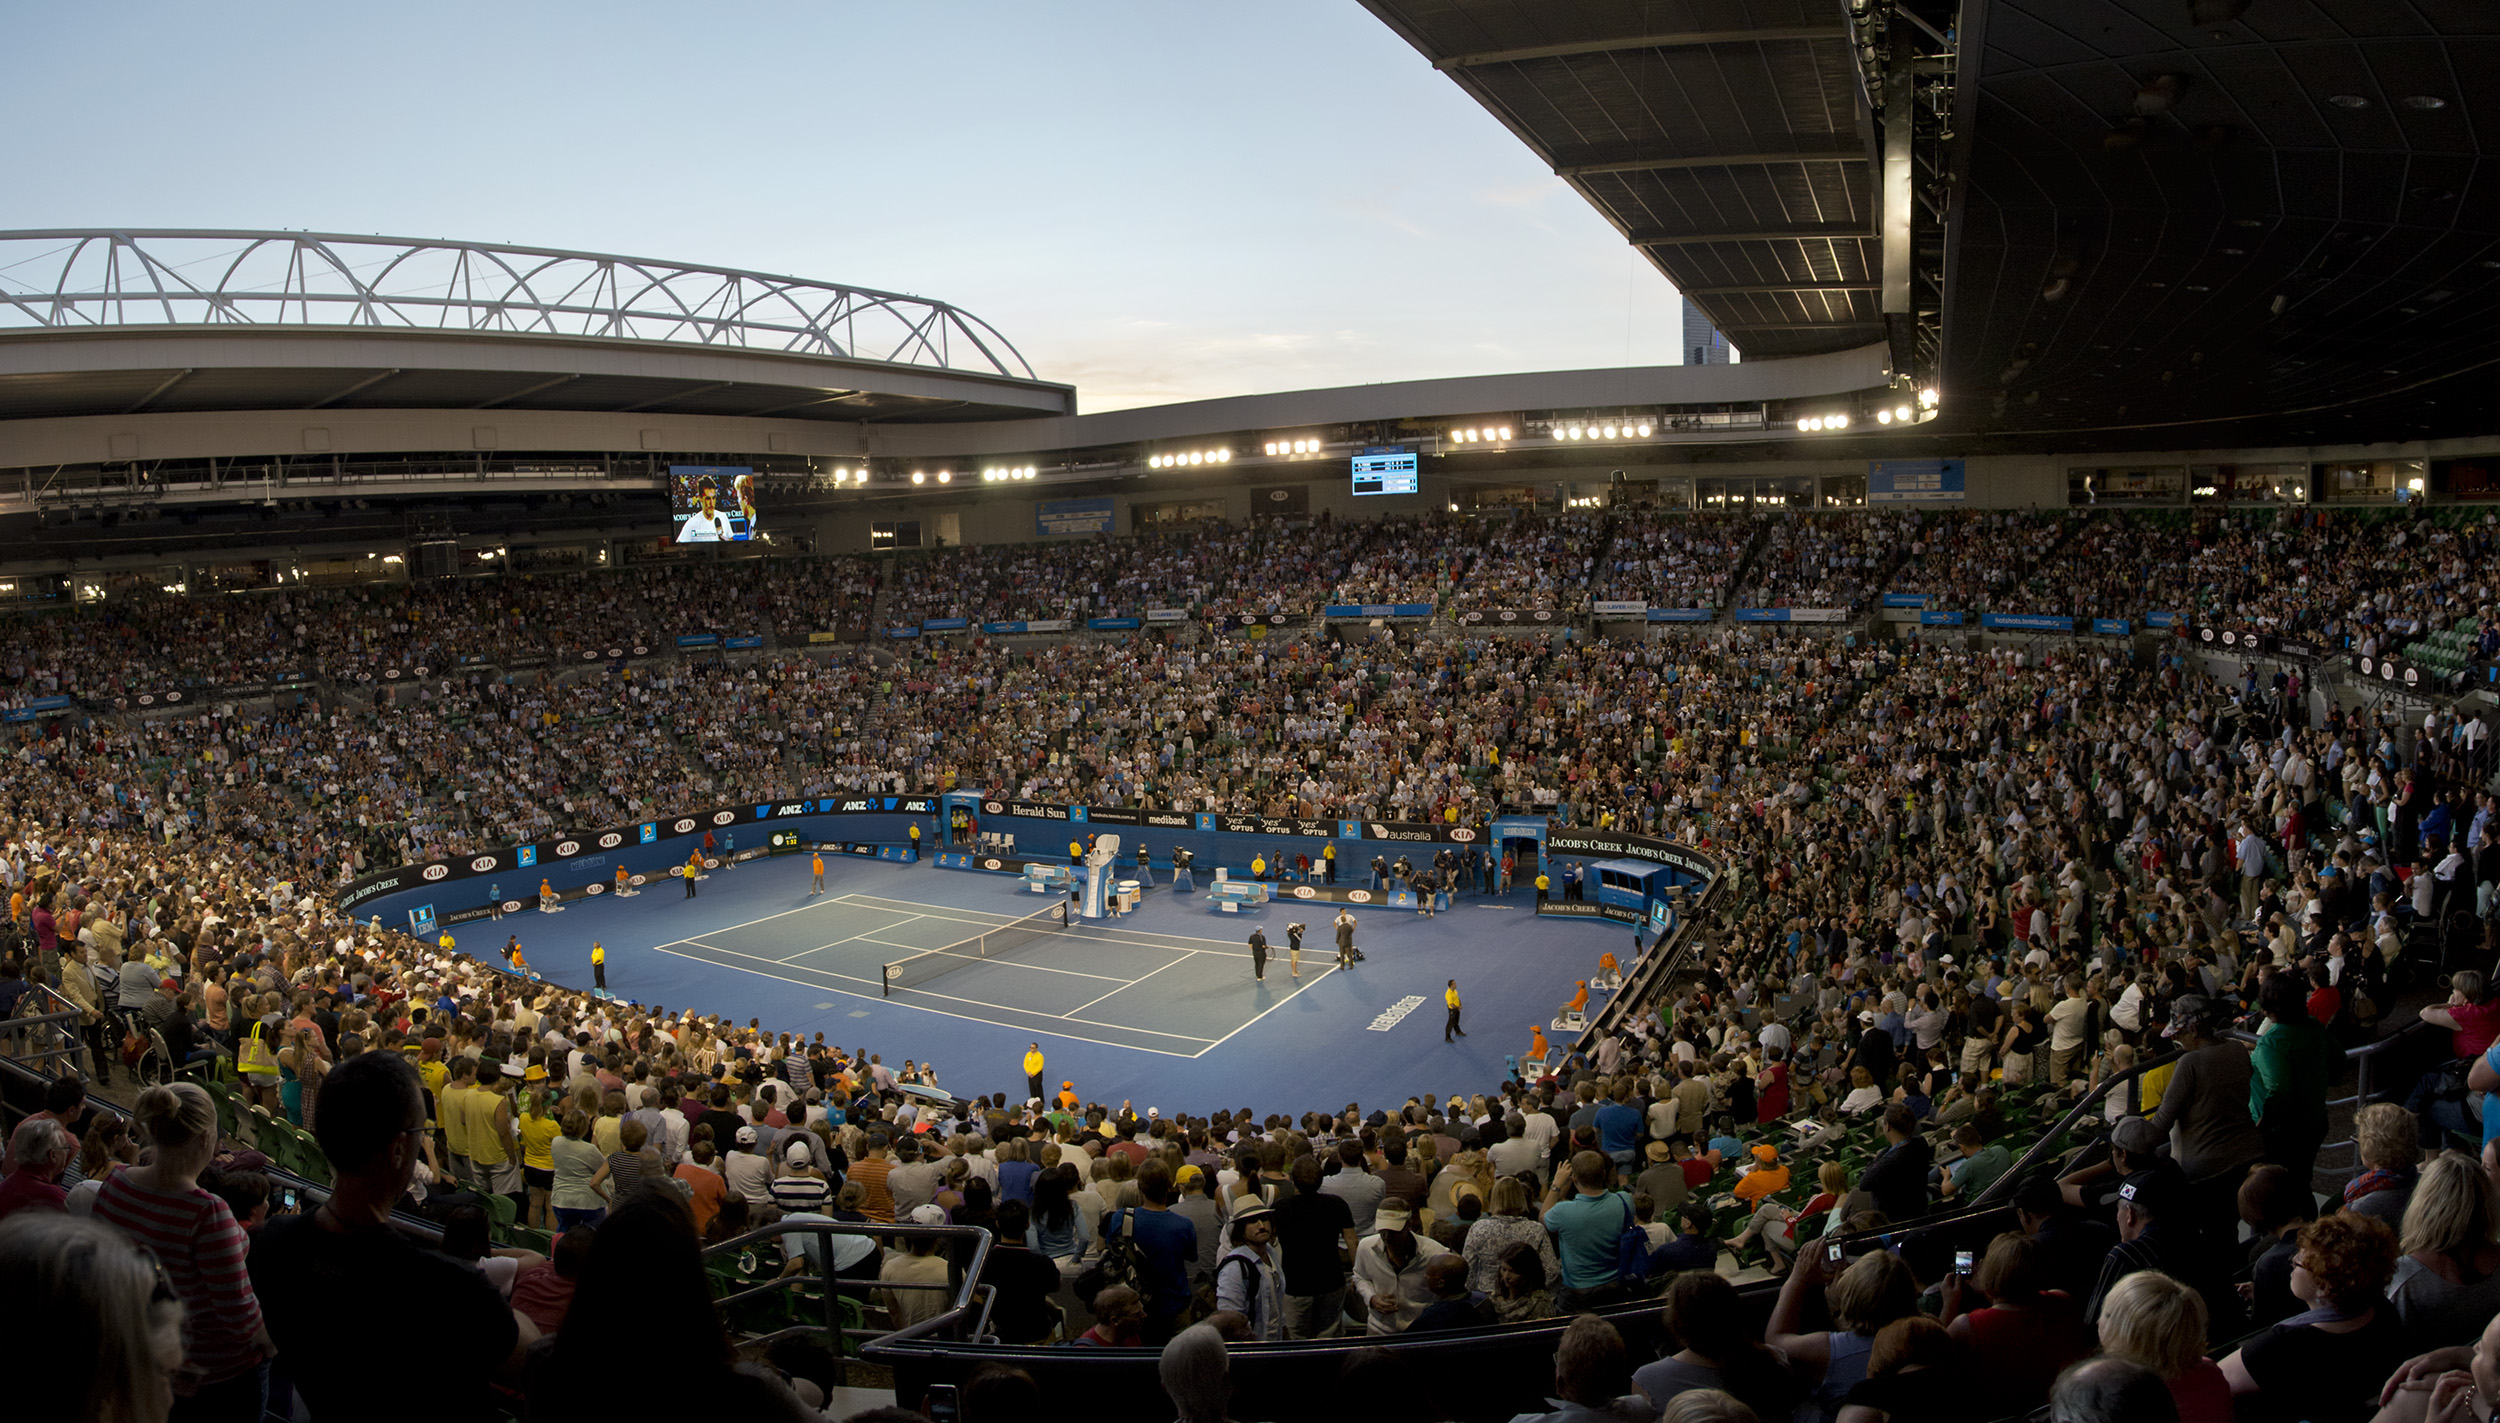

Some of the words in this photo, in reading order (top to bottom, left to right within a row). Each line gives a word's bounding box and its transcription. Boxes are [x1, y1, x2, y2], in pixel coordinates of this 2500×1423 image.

[778, 804, 802, 816] ANZ
[842, 800, 867, 811] ANZ
[905, 801, 926, 812] ANZ
[1012, 804, 1045, 817] Herald
[1046, 806, 1067, 819] Sun
[1148, 814, 1188, 826] medibank
[1230, 824, 1254, 833] OPTUS
[1265, 826, 1291, 834] OPTUS
[1302, 828, 1328, 836] OPTUS
[1389, 830, 1431, 841] australia
[821, 843, 835, 851] ANZ
[1549, 837, 1588, 849] JACOB'S
[1590, 839, 1622, 852] CREEK
[1626, 843, 1658, 858] JACOB'S
[1659, 850, 1683, 866] CREEK
[355, 884, 377, 900] JACOB'S
[376, 877, 399, 892] CREEK
[1542, 903, 1571, 912] JACOB'S
[1572, 903, 1597, 913] CREEK
[1604, 906, 1627, 918] JACOB'S
[1627, 911, 1648, 922] CEK
[449, 911, 472, 921] JACOB'S
[471, 908, 492, 918] CREEK
[416, 920, 435, 935] IBM
